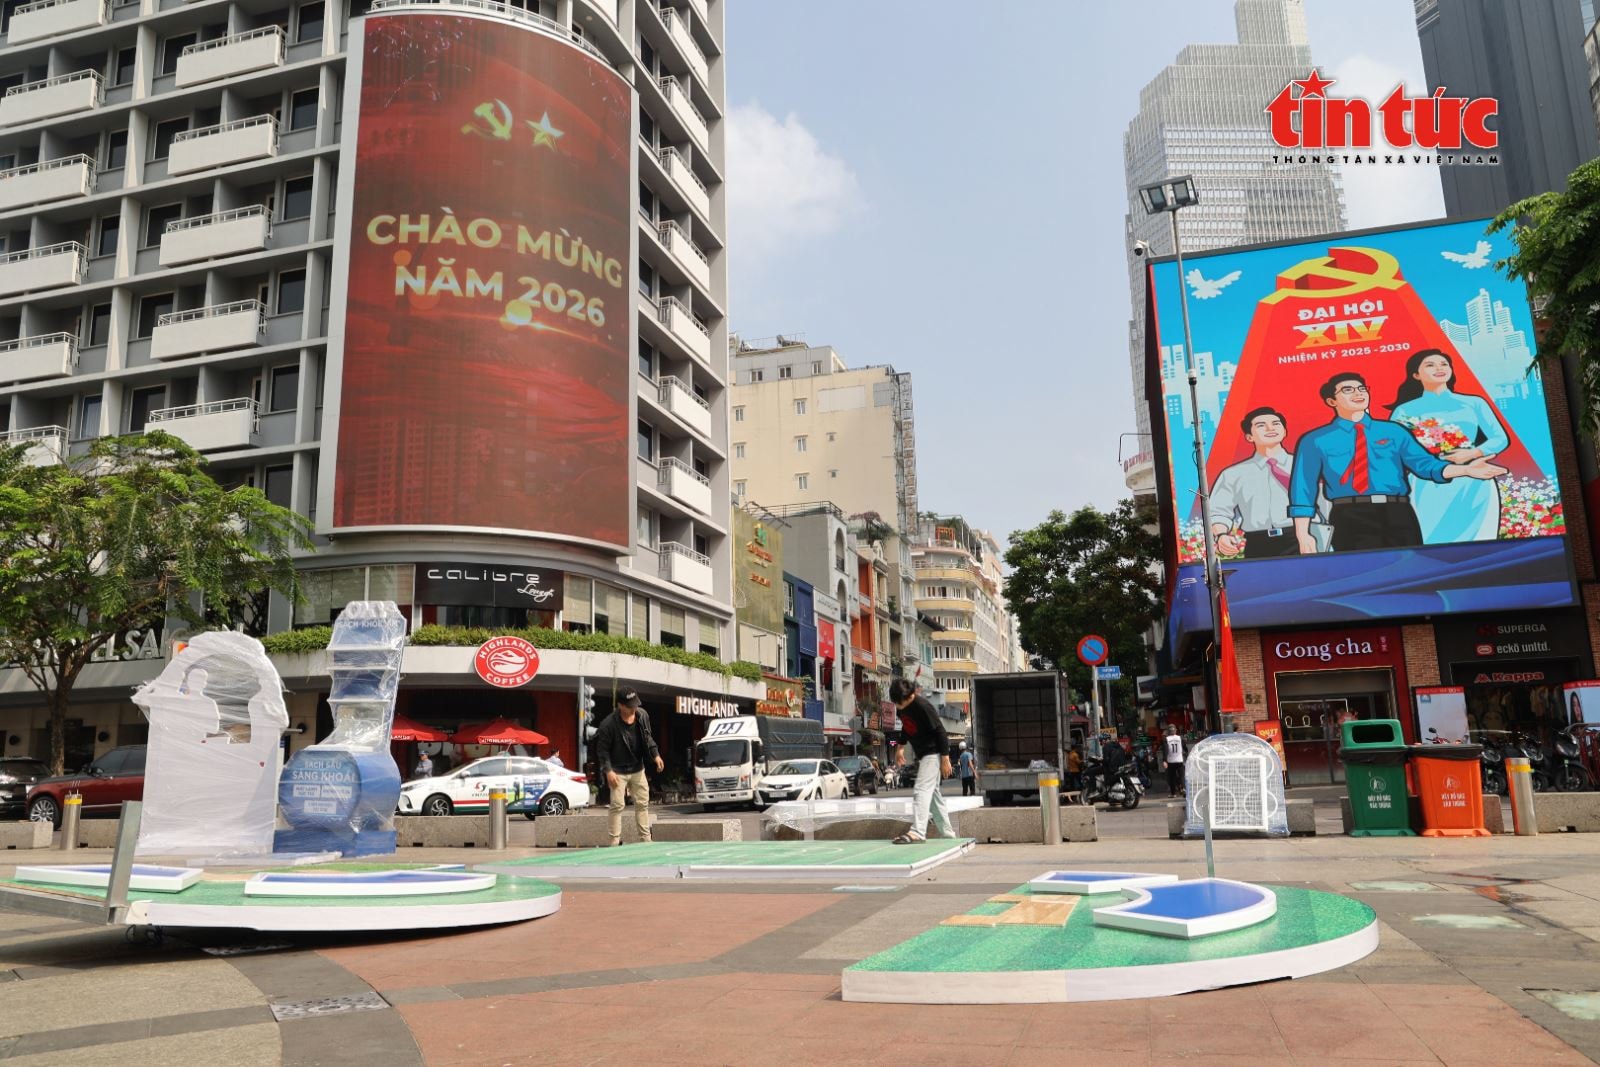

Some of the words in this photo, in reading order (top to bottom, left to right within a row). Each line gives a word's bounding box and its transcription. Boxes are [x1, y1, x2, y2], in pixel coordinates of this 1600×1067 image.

[367, 206, 502, 248] CHÀO
[517, 225, 622, 288] MỪNG
[395, 257, 503, 301] NĂM
[517, 276, 605, 327] 2026
[1297, 305, 1336, 321] ĐẠI
[1343, 299, 1384, 316] HỘI
[1293, 315, 1389, 349] XIV
[1278, 352, 1317, 364] NHIỆM
[1321, 349, 1337, 360] KỲ
[1341, 346, 1372, 357] 2025
[1379, 342, 1410, 353] 2030
[1497, 623, 1547, 634] SUPERGA
[479, 639, 537, 660] HIGHLANDS
[1275, 642, 1332, 661] Gong
[1335, 638, 1373, 655] cha
[485, 673, 530, 685] COFFEE
[1492, 671, 1544, 683] Kappa
[675, 696, 740, 718] HIGHLANDS
